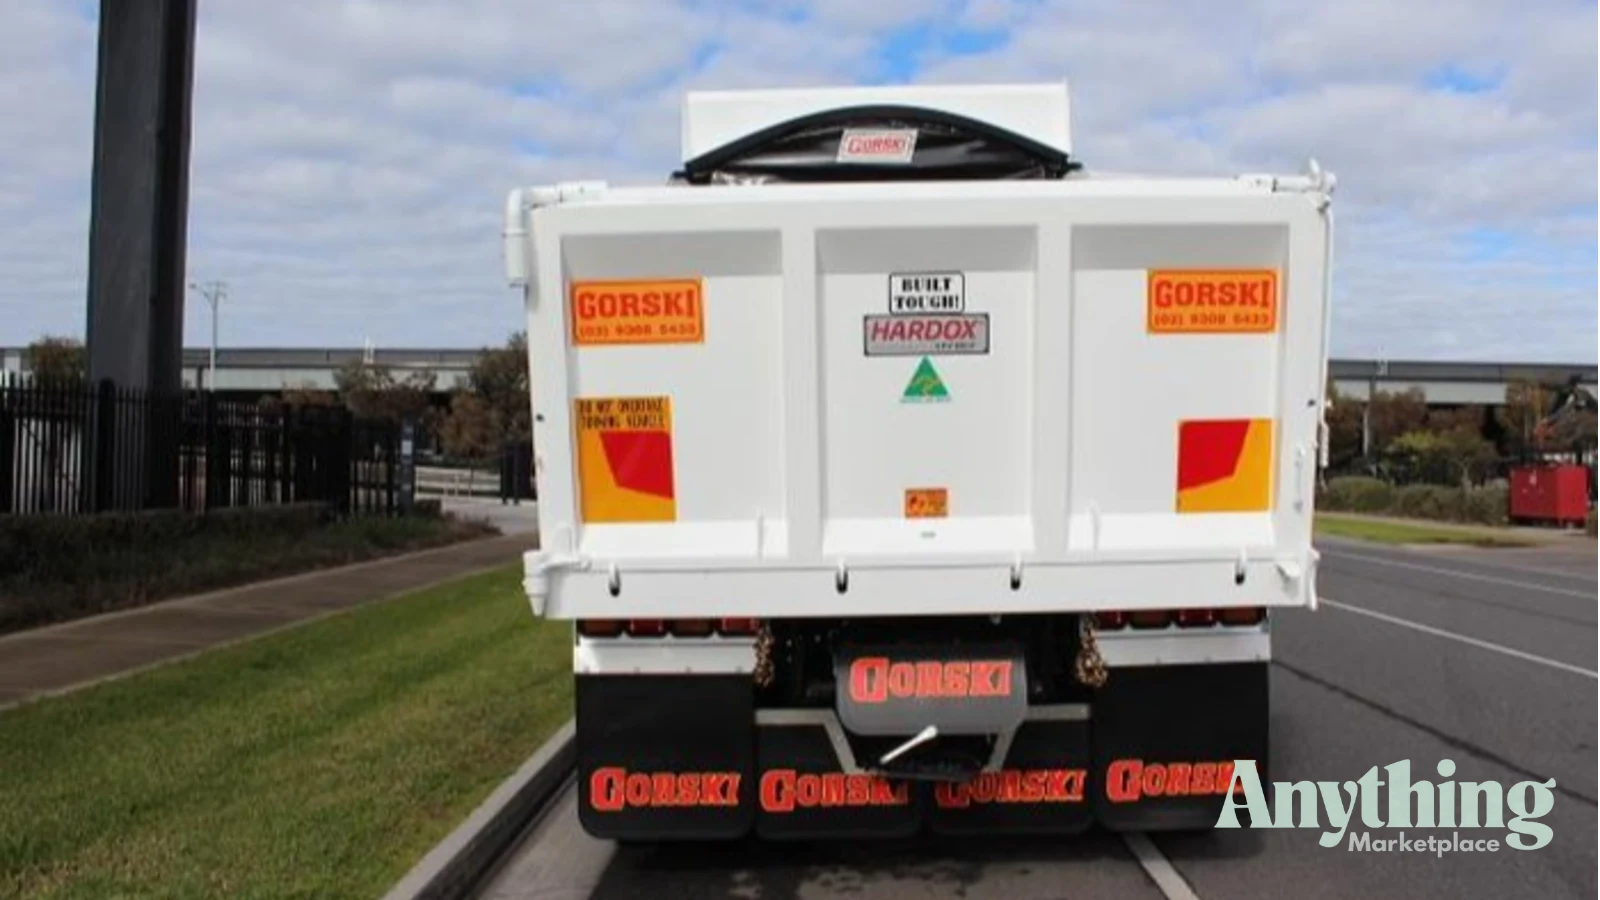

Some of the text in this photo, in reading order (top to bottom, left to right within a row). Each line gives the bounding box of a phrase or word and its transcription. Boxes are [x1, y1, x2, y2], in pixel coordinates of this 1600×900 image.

[902, 277, 951, 292] BUILT
[1154, 279, 1270, 309] GORSKI
[577, 288, 695, 319] GORSKI
[895, 295, 959, 310] TOUGH!
[871, 319, 978, 342] HARDOX
[850, 656, 1012, 704] GORSKI
[591, 766, 741, 812] GORSKI
[1106, 760, 1245, 803] GORSK
